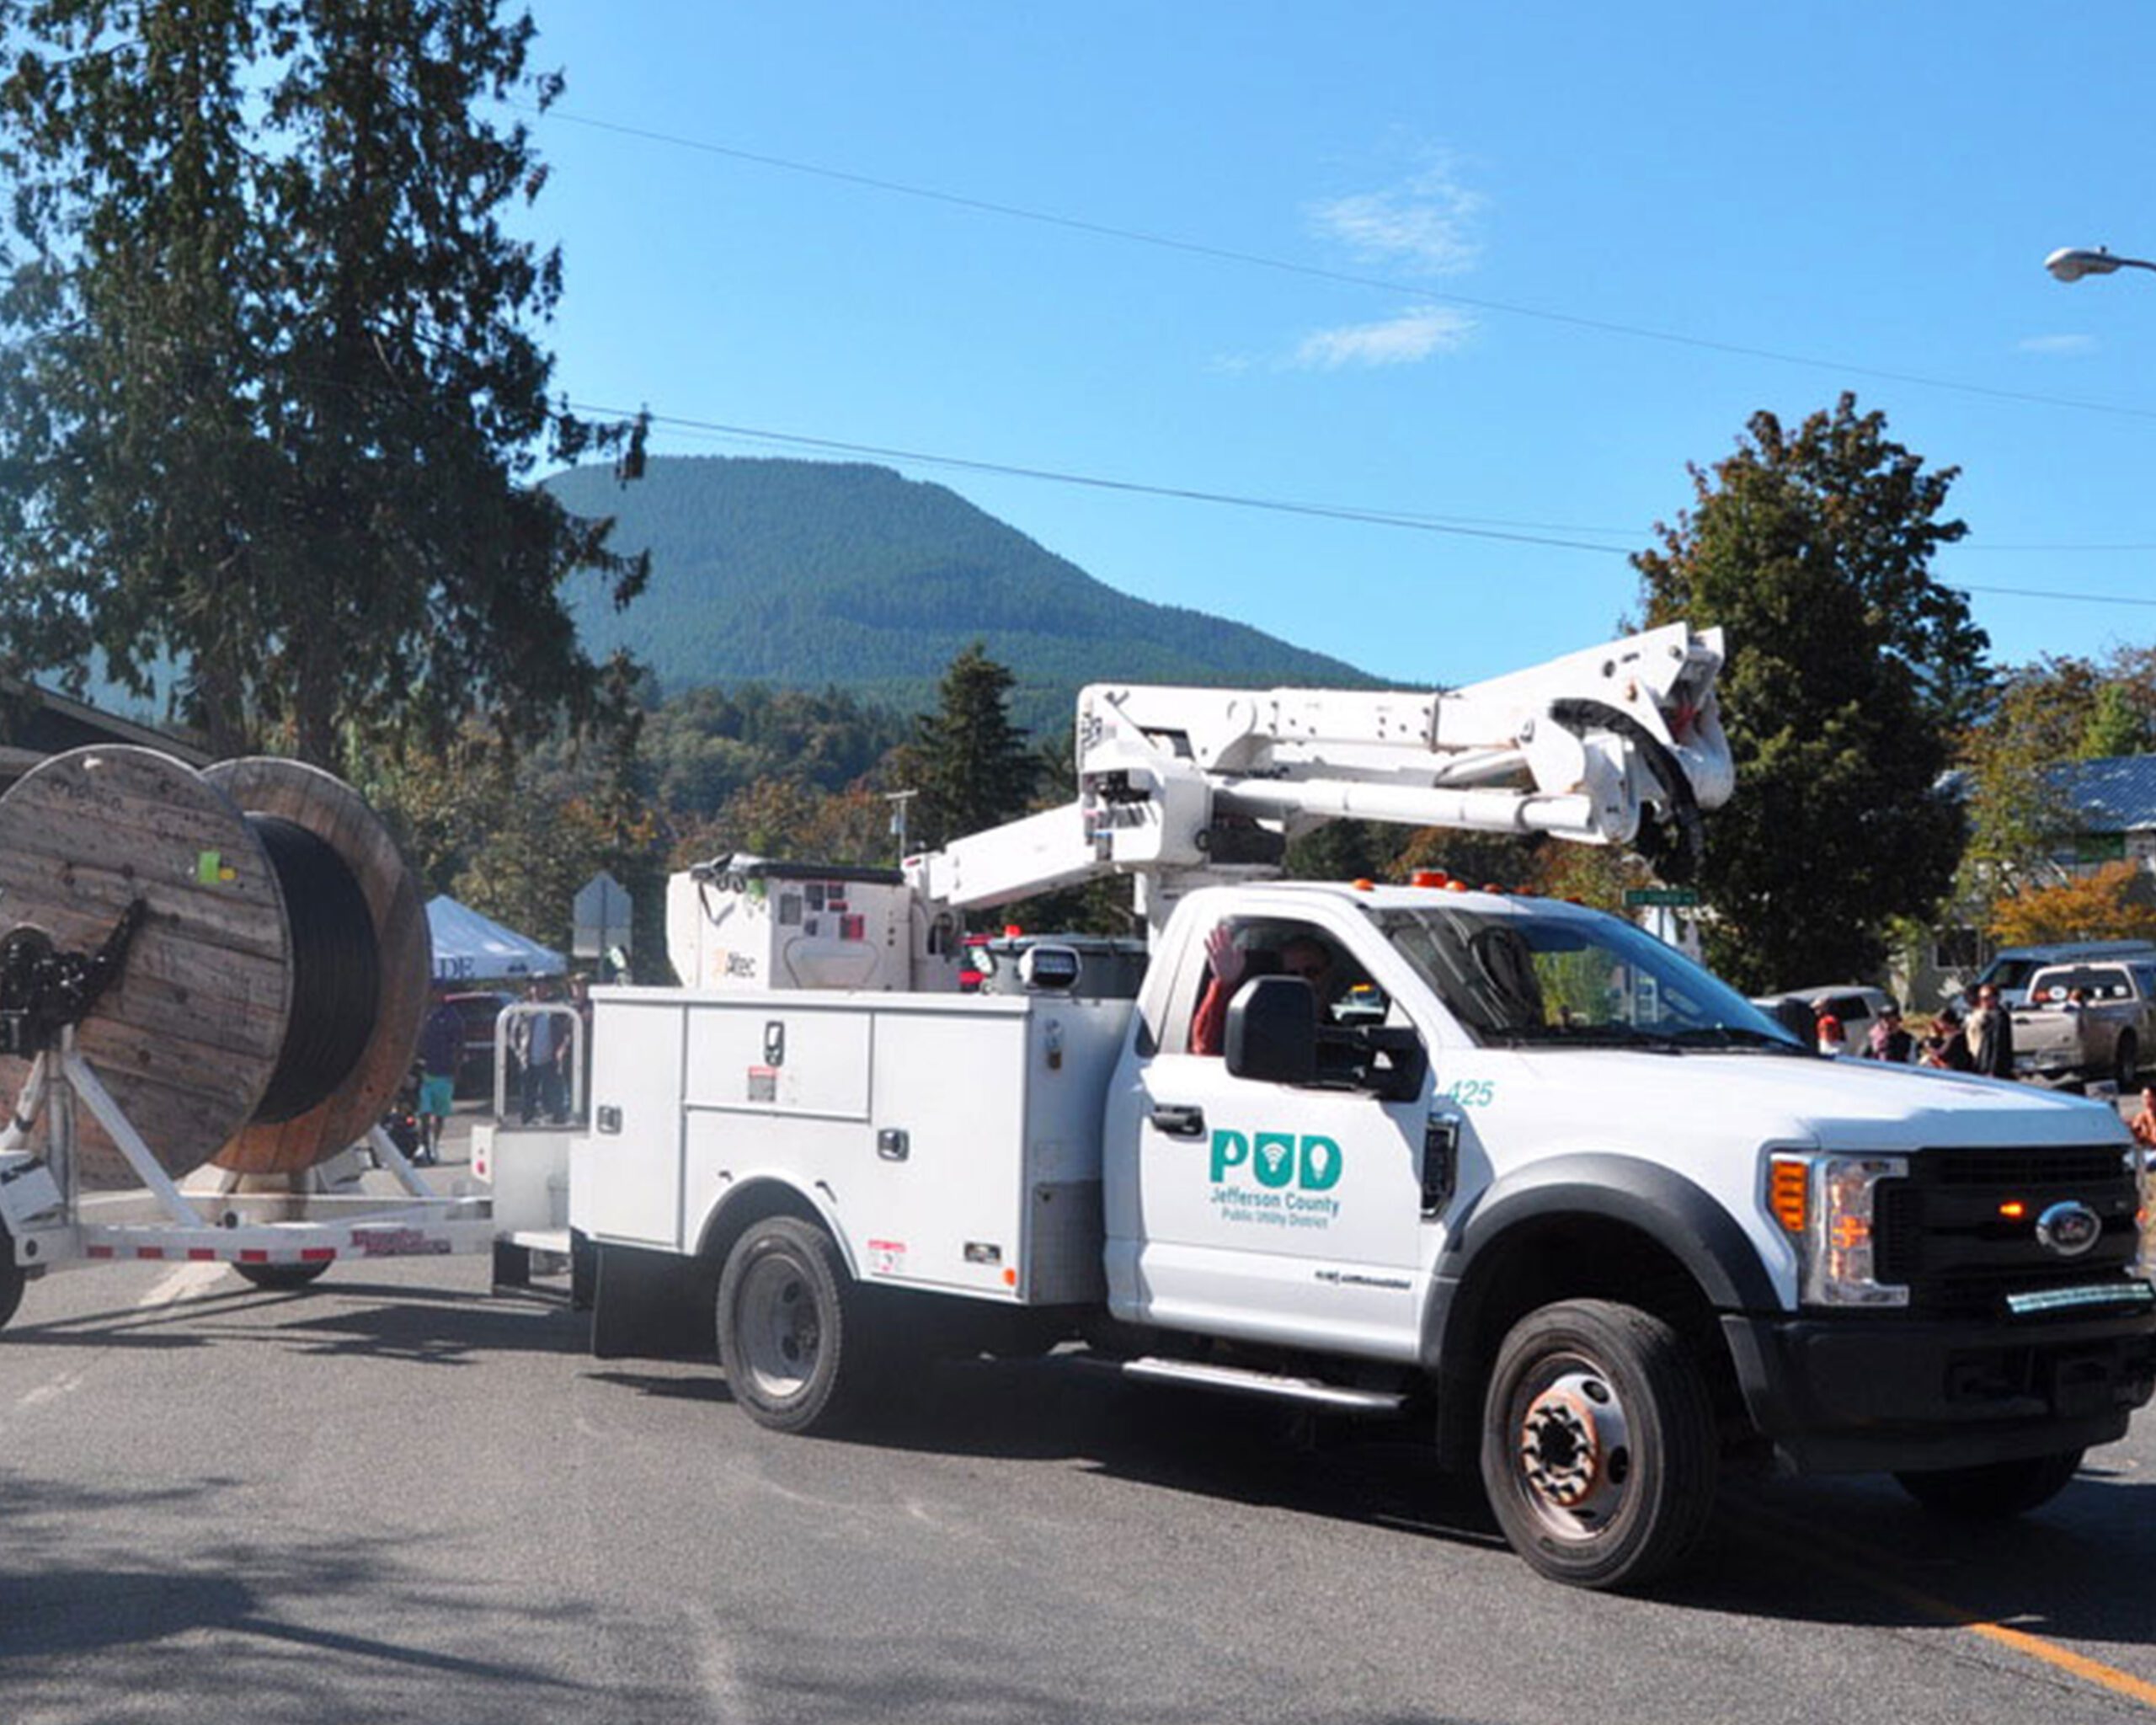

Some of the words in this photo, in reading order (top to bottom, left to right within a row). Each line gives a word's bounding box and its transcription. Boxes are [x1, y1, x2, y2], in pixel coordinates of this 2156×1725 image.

[430, 956, 475, 980] DE
[1448, 1080, 1495, 1108] 425
[1210, 1129, 1343, 1192] PUD
[1210, 1187, 1281, 1208] Jefferson
[1285, 1193, 1339, 1217] County
[1221, 1207, 1252, 1221] Public
[1257, 1210, 1286, 1226] Utility
[1289, 1214, 1328, 1230] District
